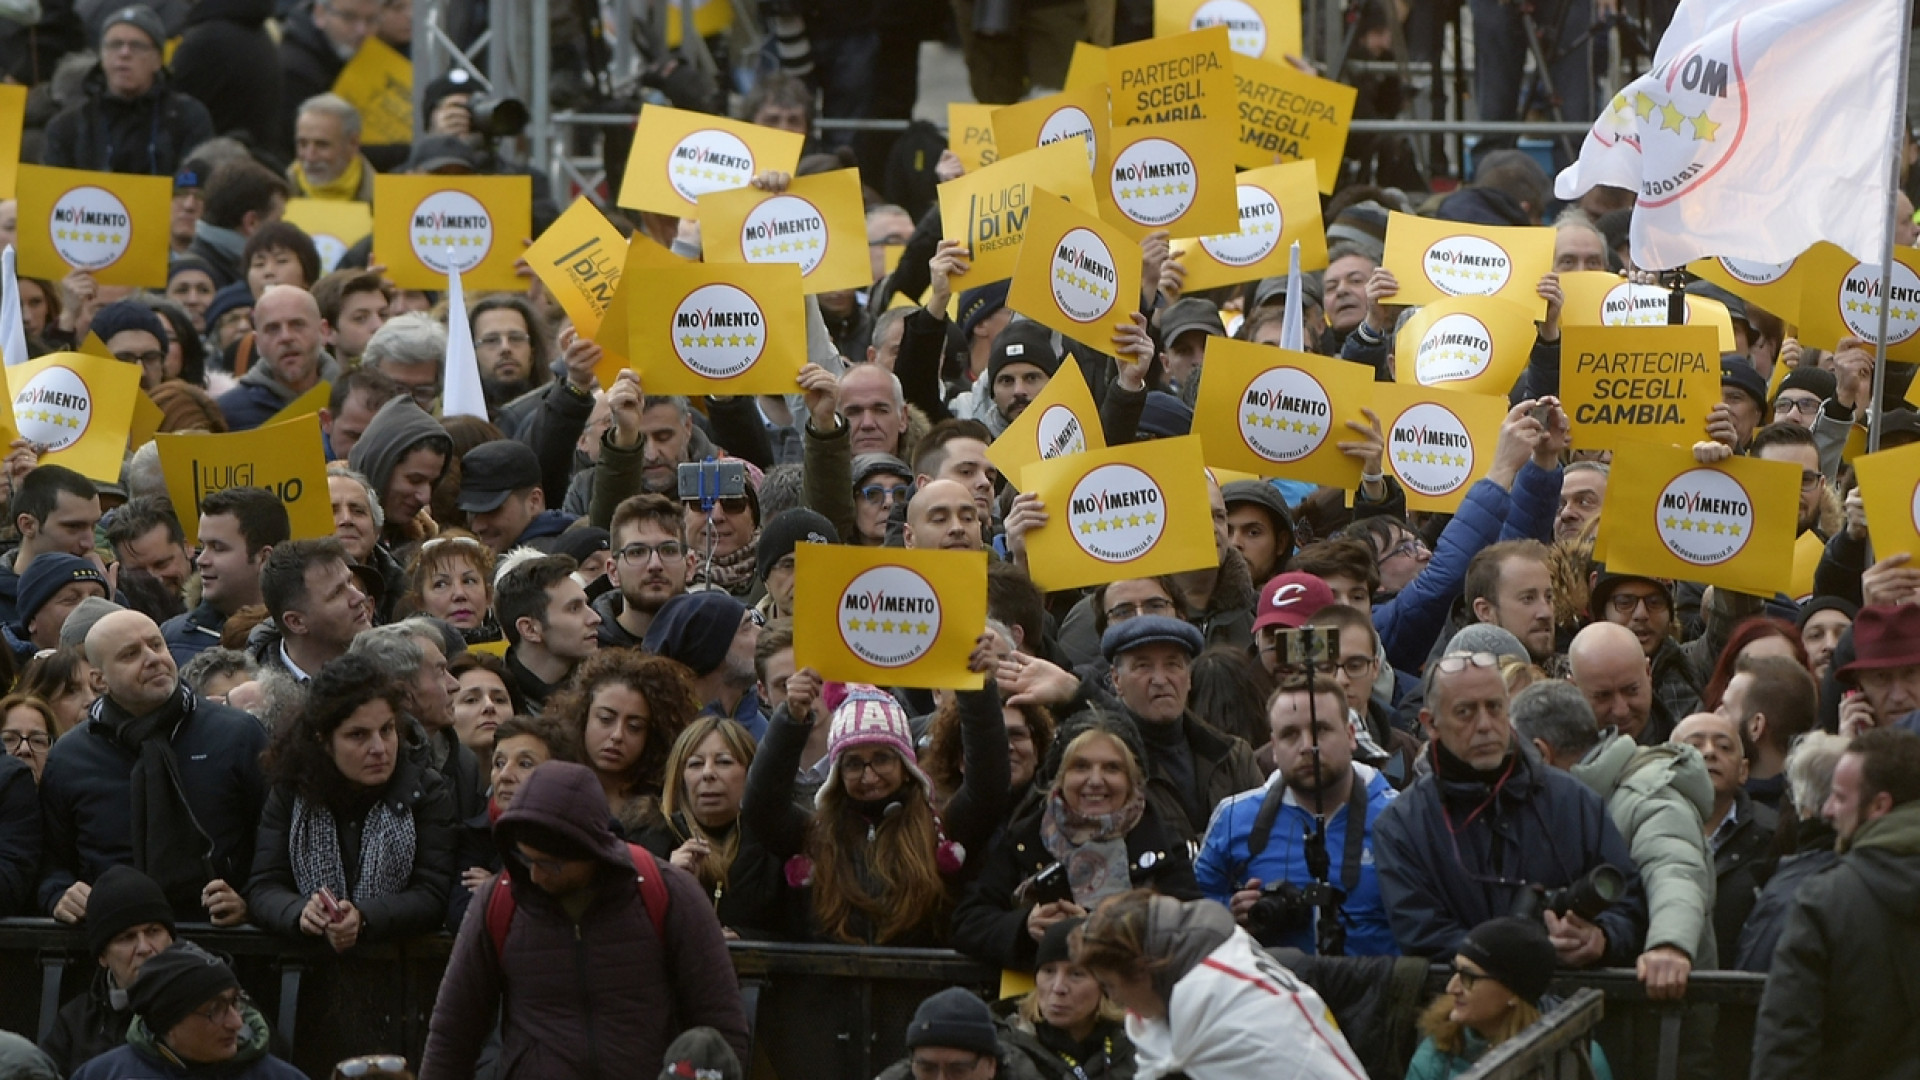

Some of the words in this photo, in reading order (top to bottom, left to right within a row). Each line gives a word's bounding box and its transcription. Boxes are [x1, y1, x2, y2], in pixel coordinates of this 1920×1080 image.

[1121, 51, 1222, 90] PARTECIPA.
[1136, 79, 1205, 111] SCEGLI.
[1237, 101, 1310, 140] SCEGLI.
[676, 146, 750, 171] MOVIMENTO
[1115, 160, 1190, 183] MOVIMENTO
[980, 182, 1026, 218] LUIGI
[55, 206, 126, 227] MOVIMENTO
[415, 210, 487, 232] MOVIMENTO
[746, 217, 820, 240] MOVIMENTO
[980, 214, 1000, 241] DI
[980, 233, 1025, 254] PRESIDEN
[1058, 245, 1114, 283] MOVIMENTO
[1430, 249, 1506, 268] MOVIMENTO
[1845, 277, 1920, 303] MOVIENTO
[1606, 294, 1667, 314] MOVIMEN
[678, 306, 759, 331] MOVIMENTO
[1419, 330, 1489, 356] MOVIMENTO
[1575, 352, 1710, 375] PARTECIPA.
[16, 385, 88, 411] MOVIMENTO
[1593, 378, 1687, 400] SCEGLI.
[1246, 388, 1327, 417] MOVIMENTO
[1575, 404, 1686, 426] CAMBIA.
[1394, 424, 1468, 448] MOVIMENTO
[203, 462, 255, 491] LUIGI
[1073, 488, 1157, 516] MOVIMENTO
[1663, 491, 1747, 517] MOVIMENTO
[845, 589, 935, 614] MOVIMENTO
[1272, 583, 1308, 607] C
